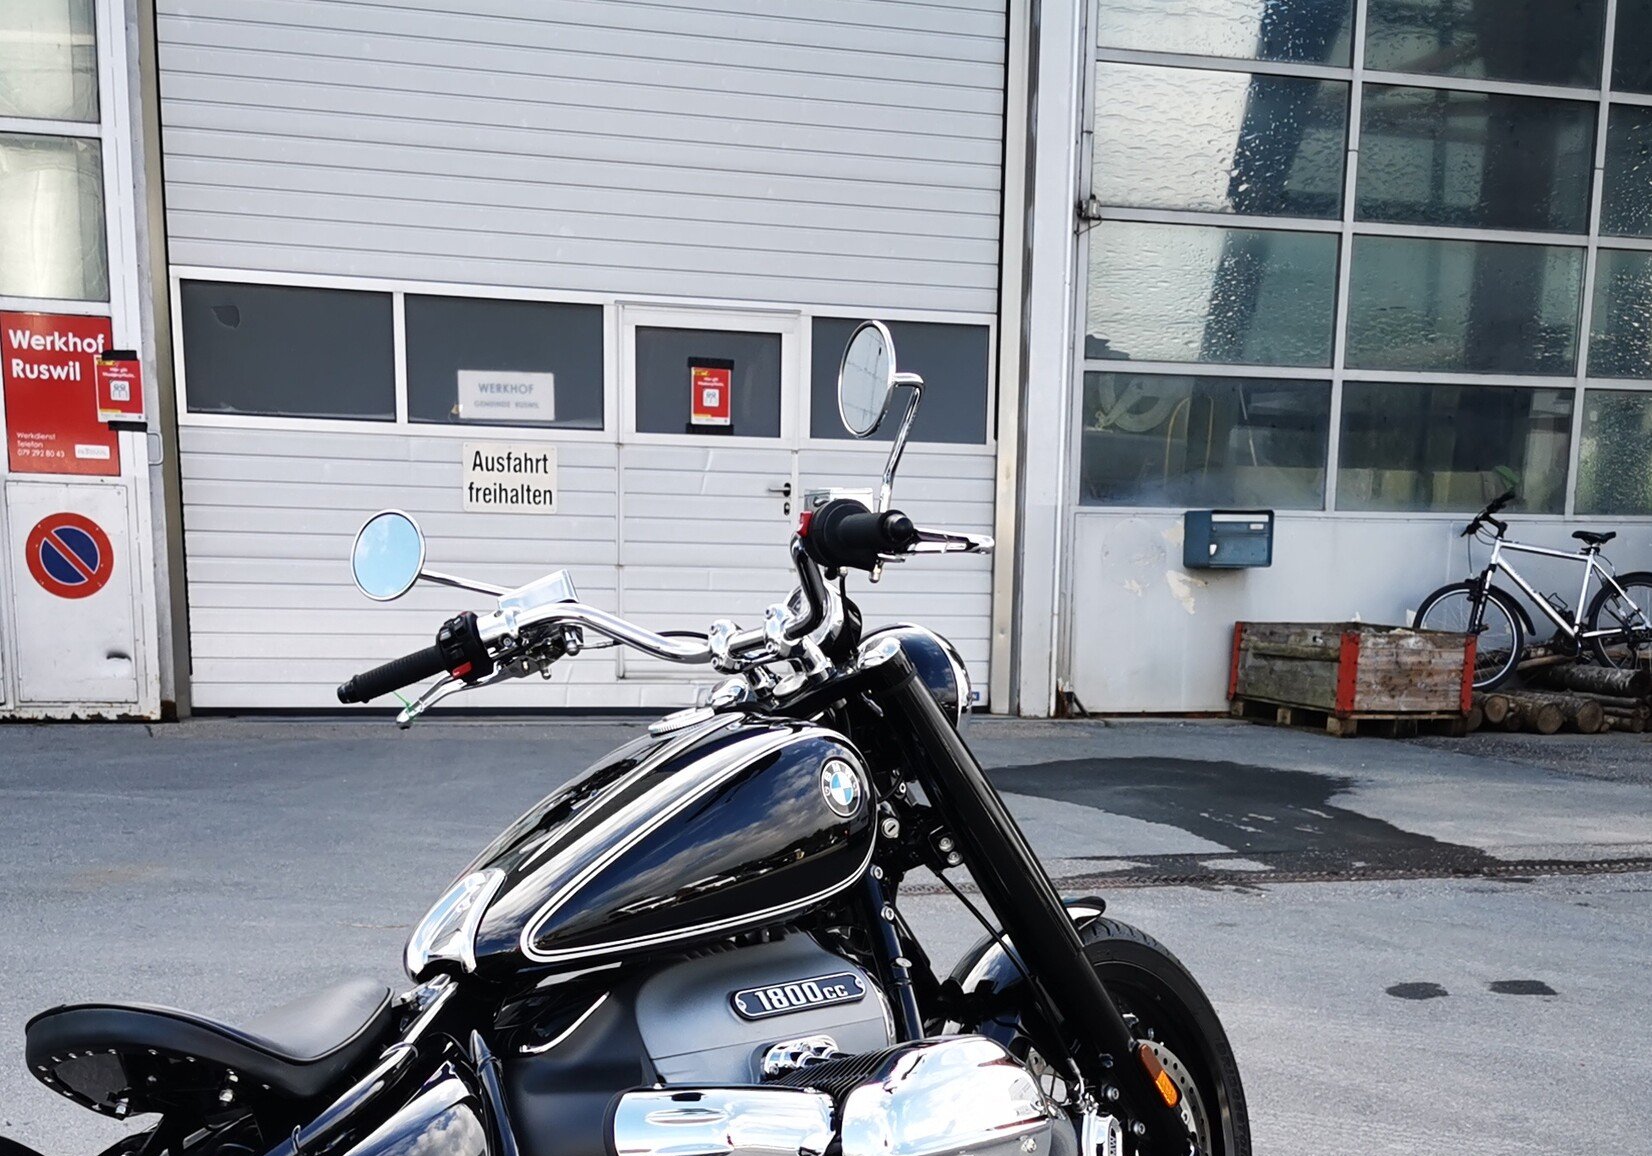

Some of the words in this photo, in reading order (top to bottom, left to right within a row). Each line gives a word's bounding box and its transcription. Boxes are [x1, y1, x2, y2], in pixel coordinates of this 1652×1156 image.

[8, 329, 105, 353] Werkhof
[11, 358, 81, 381] Ruswil
[478, 383, 534, 394] WERKHOF
[472, 450, 549, 474] Ausfahrt
[468, 481, 553, 506] freihalten
[754, 981, 849, 1011] 1800cc
